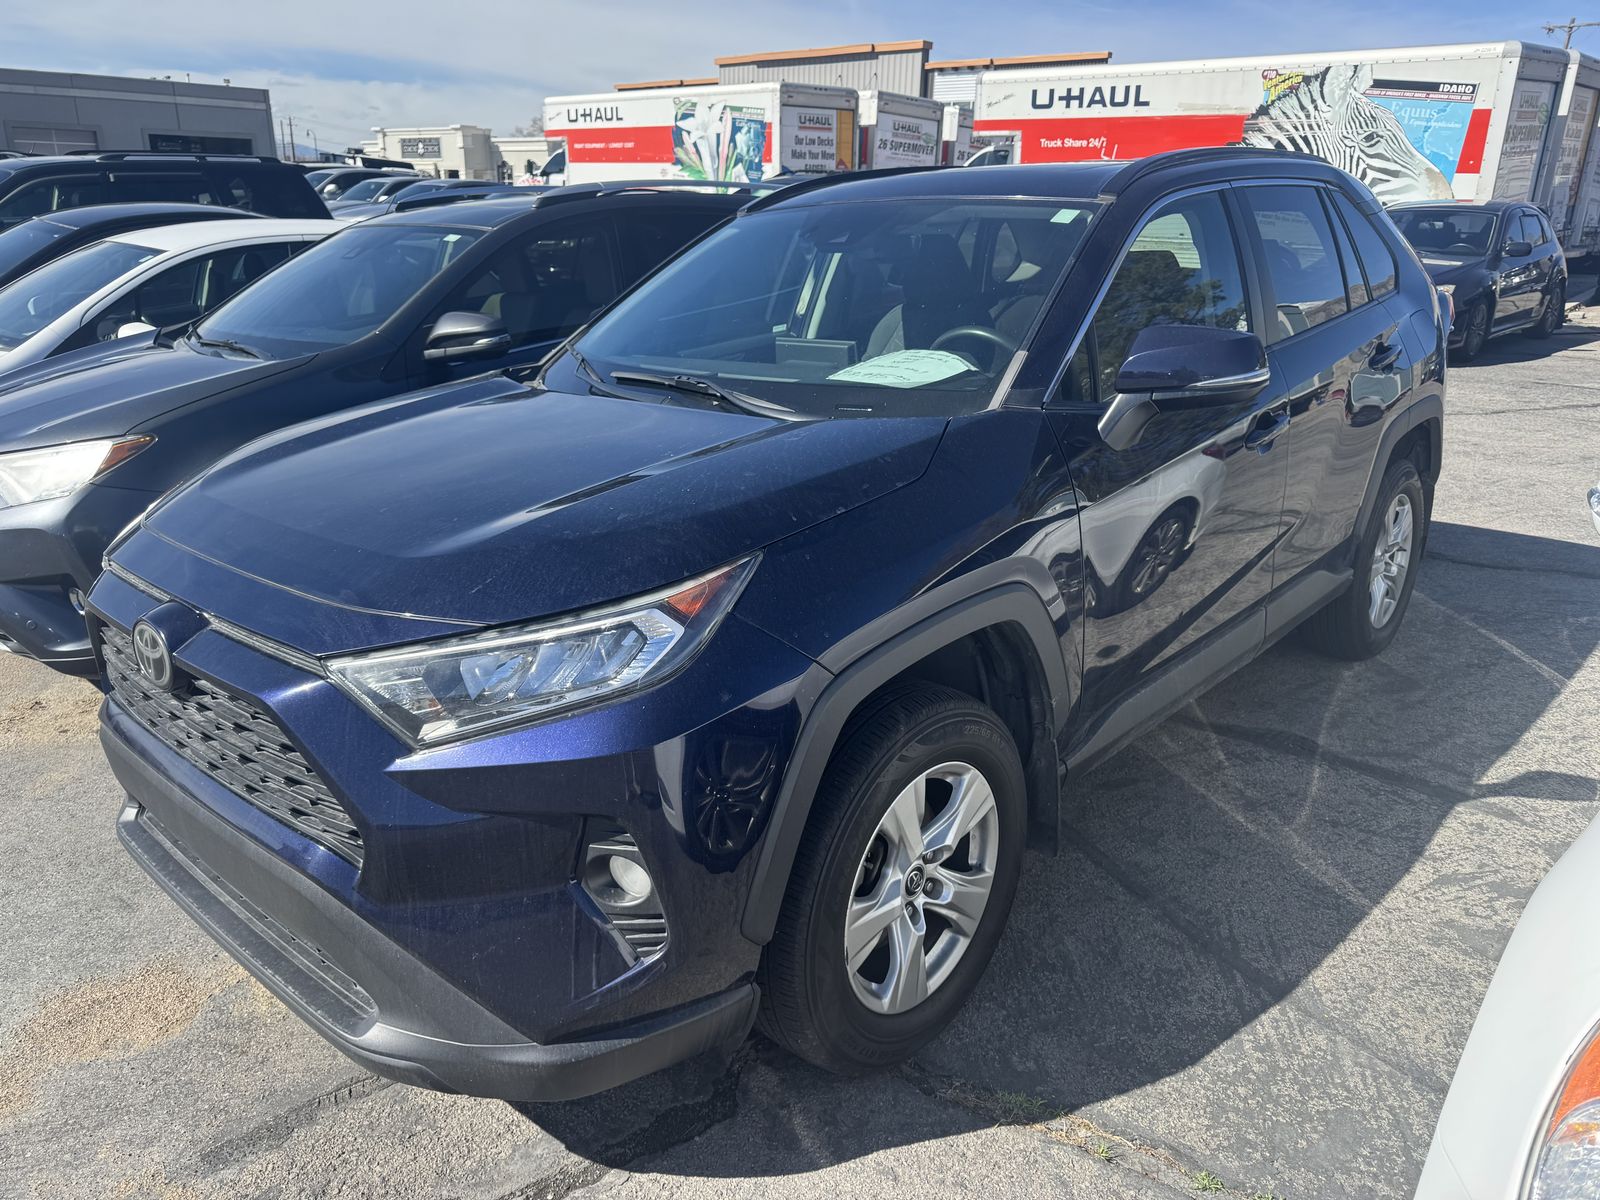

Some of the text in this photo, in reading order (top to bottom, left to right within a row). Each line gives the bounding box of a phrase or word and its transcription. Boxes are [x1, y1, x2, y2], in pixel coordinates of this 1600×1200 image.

[1439, 84, 1474, 94] IDAHO
[1031, 85, 1150, 110] U-HAUL
[567, 107, 623, 123] U-HAUL
[798, 115, 832, 126] U-HAUL
[893, 121, 921, 134] U-HAUL
[795, 135, 834, 147] Our Low Decks
[878, 138, 887, 150] 26
[889, 140, 935, 156] SUPERMOVER
[1040, 138, 1062, 148] Truck
[1064, 138, 1088, 148] Share
[791, 149, 835, 161] Make Your Move
